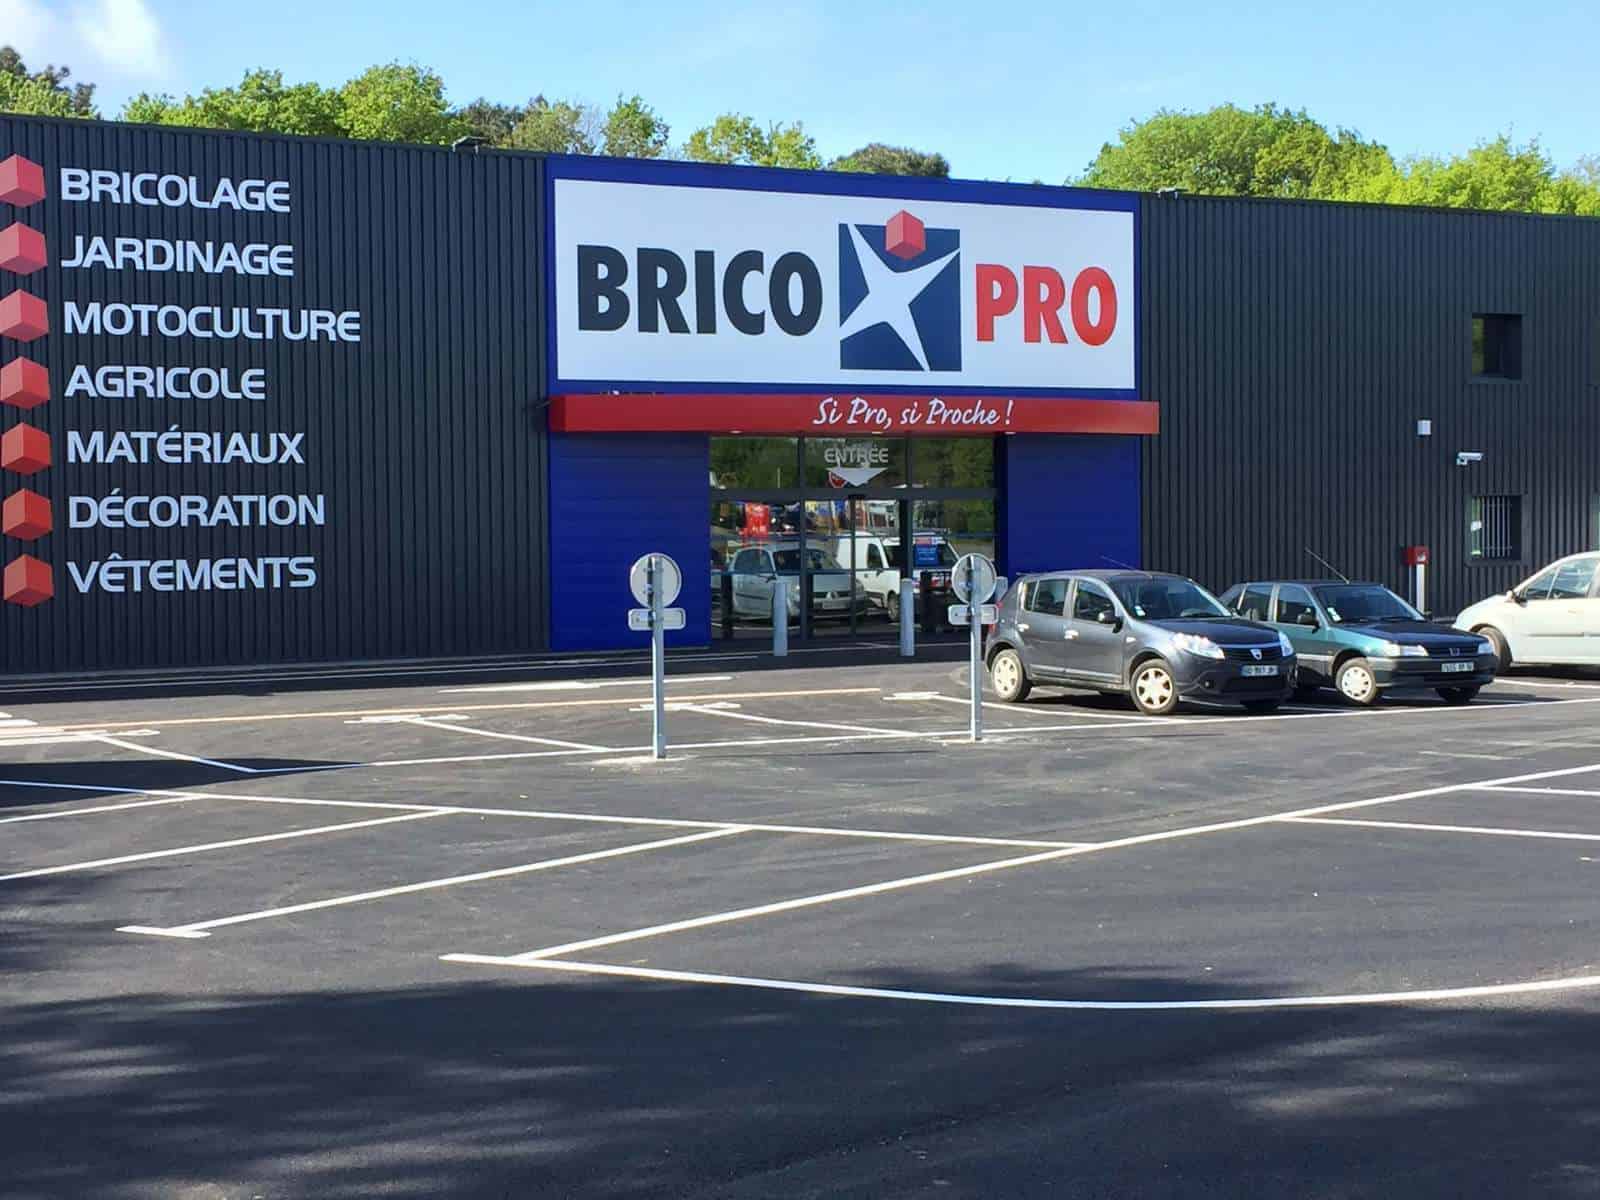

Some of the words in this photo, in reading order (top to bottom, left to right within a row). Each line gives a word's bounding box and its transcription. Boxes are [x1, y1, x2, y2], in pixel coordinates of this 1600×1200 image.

[60, 167, 291, 213] BRICOLAGE
[61, 235, 294, 276] JARDINAGE
[576, 244, 823, 337] BRICO
[975, 264, 1118, 346] PRO
[63, 301, 361, 342] MOTOCULTURE
[64, 364, 266, 400] AGRICOLE
[812, 396, 843, 425] Si
[846, 396, 893, 430] Pro,
[900, 398, 923, 425] si
[925, 397, 1001, 425] Proche
[1004, 399, 1015, 425] !
[67, 424, 305, 464] MATÉRIAUX
[68, 487, 325, 529] DÉCORATION
[66, 552, 316, 593] VÊTEMENTS
